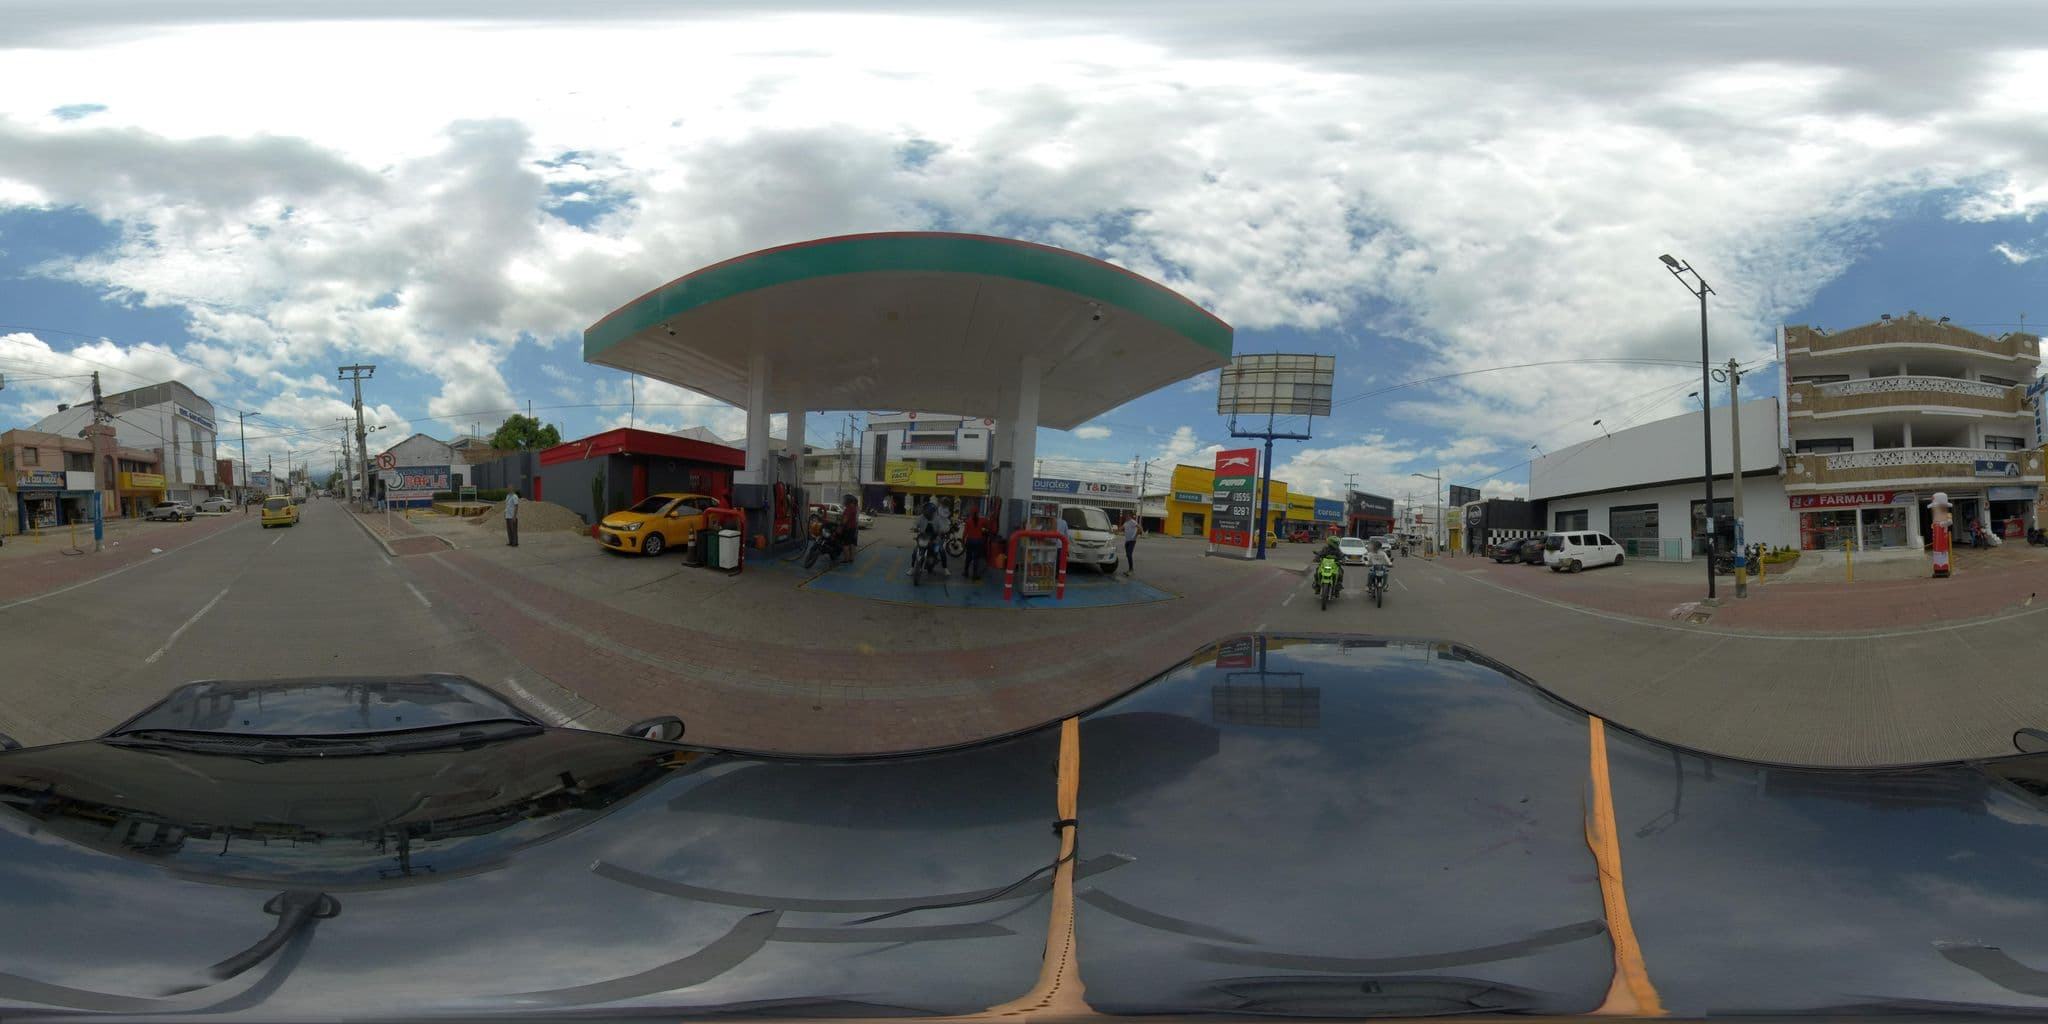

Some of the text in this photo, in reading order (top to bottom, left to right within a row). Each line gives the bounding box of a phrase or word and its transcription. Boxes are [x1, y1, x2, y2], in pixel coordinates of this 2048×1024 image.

[1085, 482, 1107, 492] T&D
[1819, 494, 1886, 505] FARMALID
[1233, 506, 1249, 516] 8287
